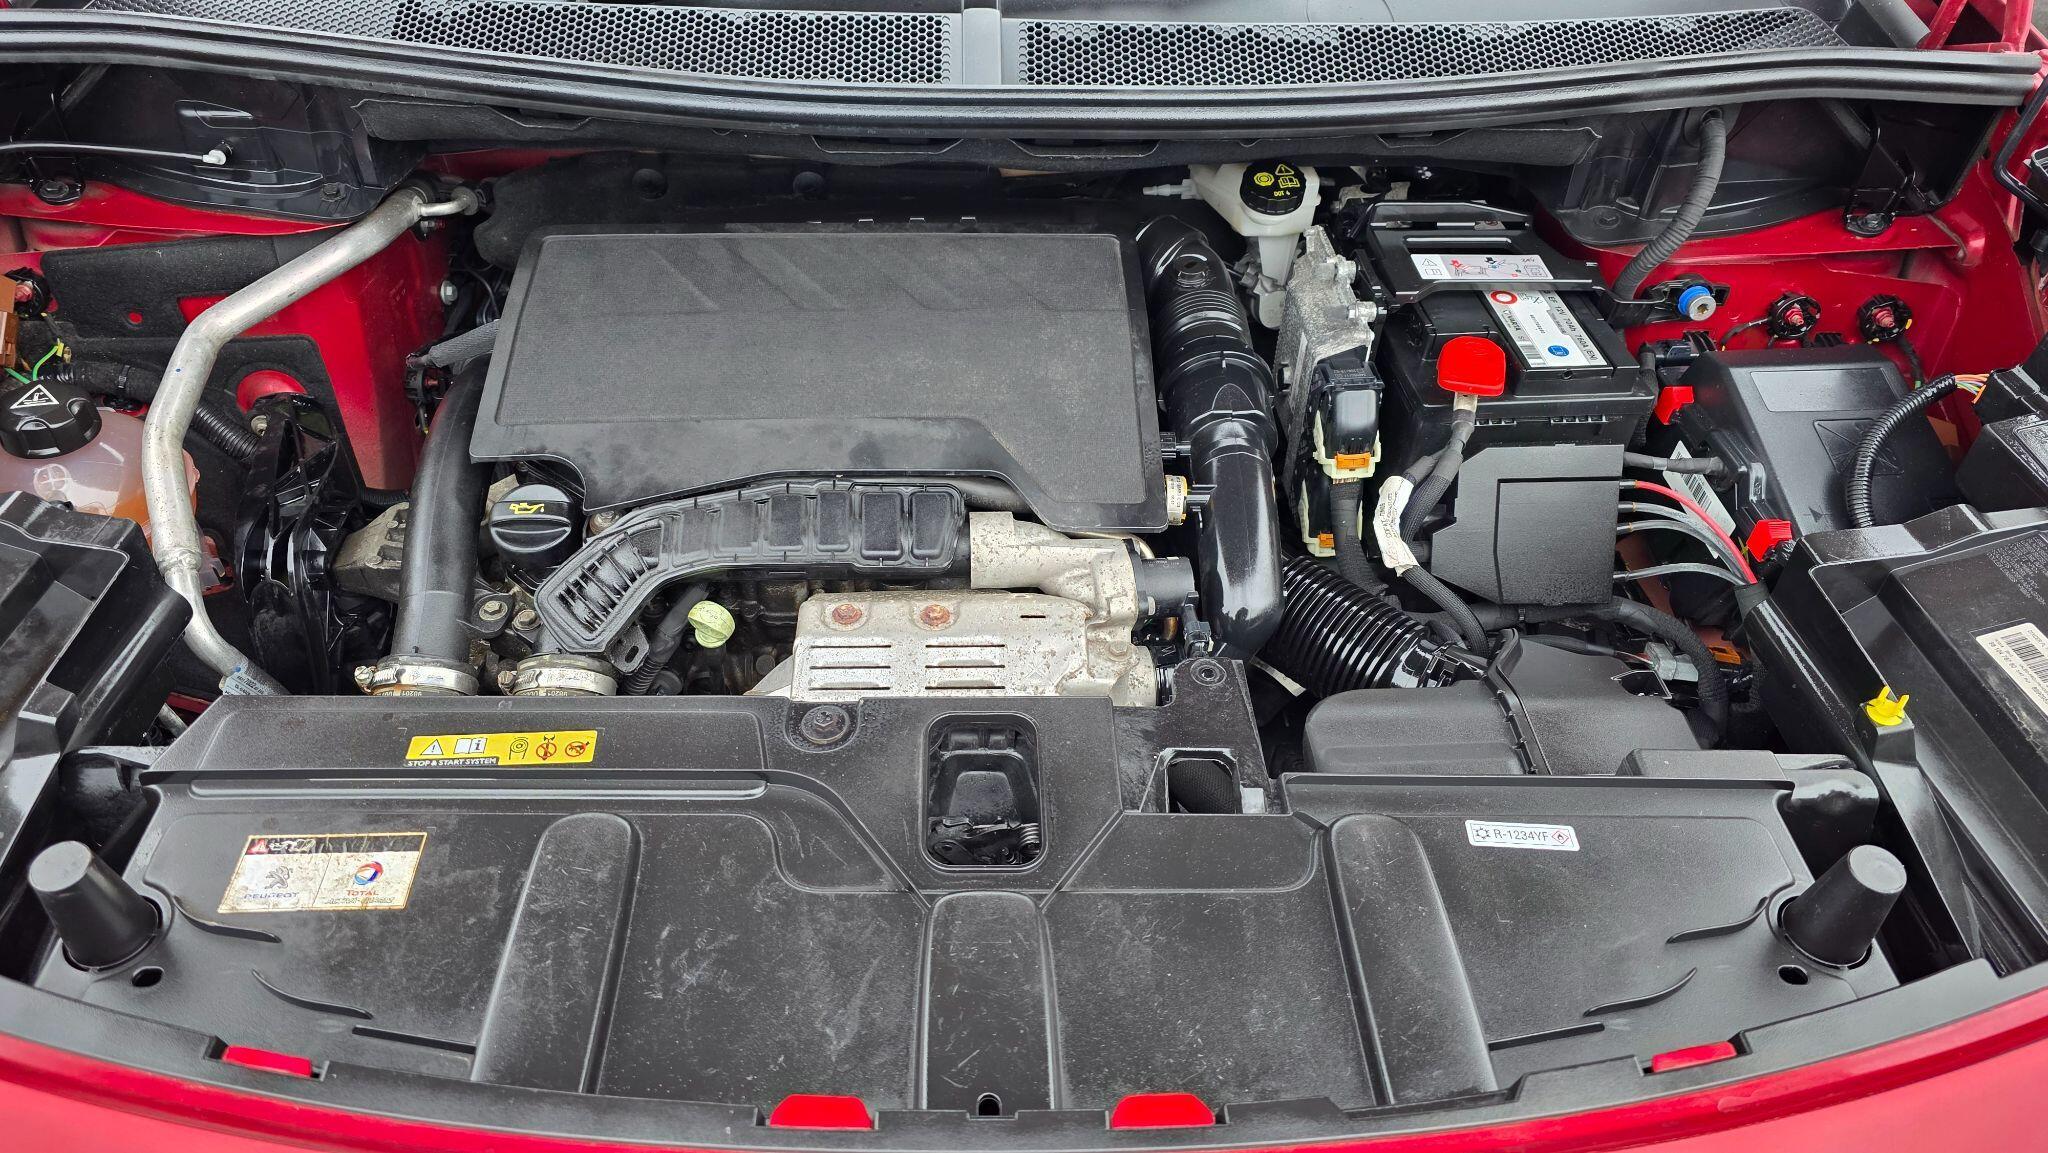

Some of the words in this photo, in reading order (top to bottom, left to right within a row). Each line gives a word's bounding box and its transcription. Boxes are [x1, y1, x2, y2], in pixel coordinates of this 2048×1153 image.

[1555, 305, 1567, 316] 12V
[464, 757, 497, 765] SYSTEM
[1493, 828, 1549, 841] R-1234YF
[244, 891, 300, 899] PEUGEOT
[346, 889, 379, 897] TOTAL
